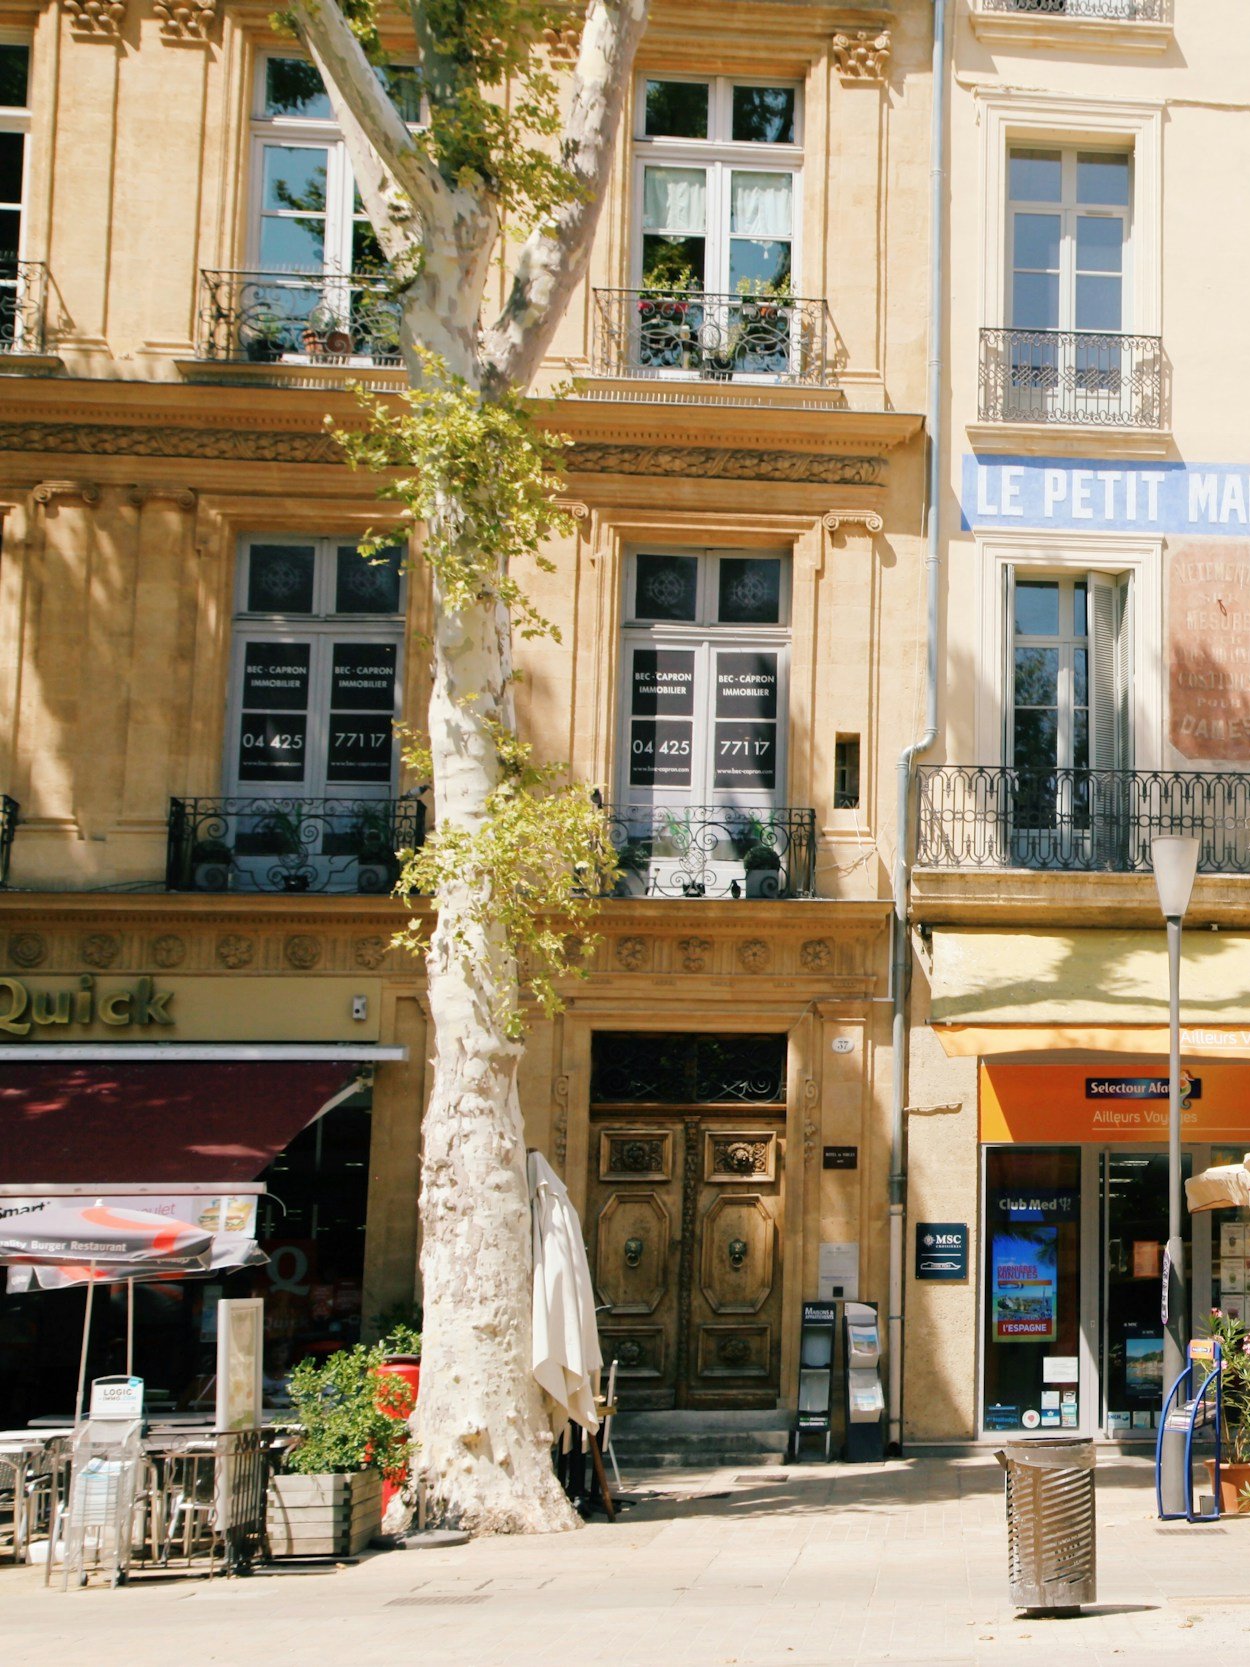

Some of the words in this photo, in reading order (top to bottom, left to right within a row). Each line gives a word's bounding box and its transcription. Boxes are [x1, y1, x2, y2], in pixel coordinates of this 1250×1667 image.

[977, 464, 1025, 516] LE
[1044, 468, 1165, 521] PETIT
[247, 666, 265, 674] BEC
[269, 666, 307, 674] CAPRON
[335, 666, 351, 674] BEC
[357, 666, 393, 675] CAPRON
[635, 673, 650, 681] BEC
[656, 673, 692, 681] CAPRON
[718, 675, 734, 683] BEC
[739, 675, 775, 683] CAPRON
[251, 679, 301, 687] IMMOBILIER
[338, 680, 388, 688] IMMOBILIER
[639, 686, 687, 694] IMMOBILIER
[722, 688, 770, 696] IMMOBILIER
[243, 733, 265, 747] 04
[269, 734, 303, 749] 425
[633, 739, 654, 754] 04
[659, 740, 690, 755] 425
[0, 974, 175, 1035] Quick
[1180, 1031, 1237, 1045] Ailleurs
[1090, 1082, 1147, 1094] Selectour
[1149, 1082, 1169, 1094] Afa
[1093, 1111, 1141, 1123] Ailleurs
[1144, 1111, 1198, 1125] Voyes
[999, 1198, 1027, 1210] Club
[1028, 1198, 1057, 1210] Med
[936, 1235, 962, 1245] MSC
[31, 1241, 67, 1252] Burger
[70, 1241, 127, 1252] Restaurant
[266, 1246, 311, 1296] Q
[998, 1271, 1038, 1280] MINUTES
